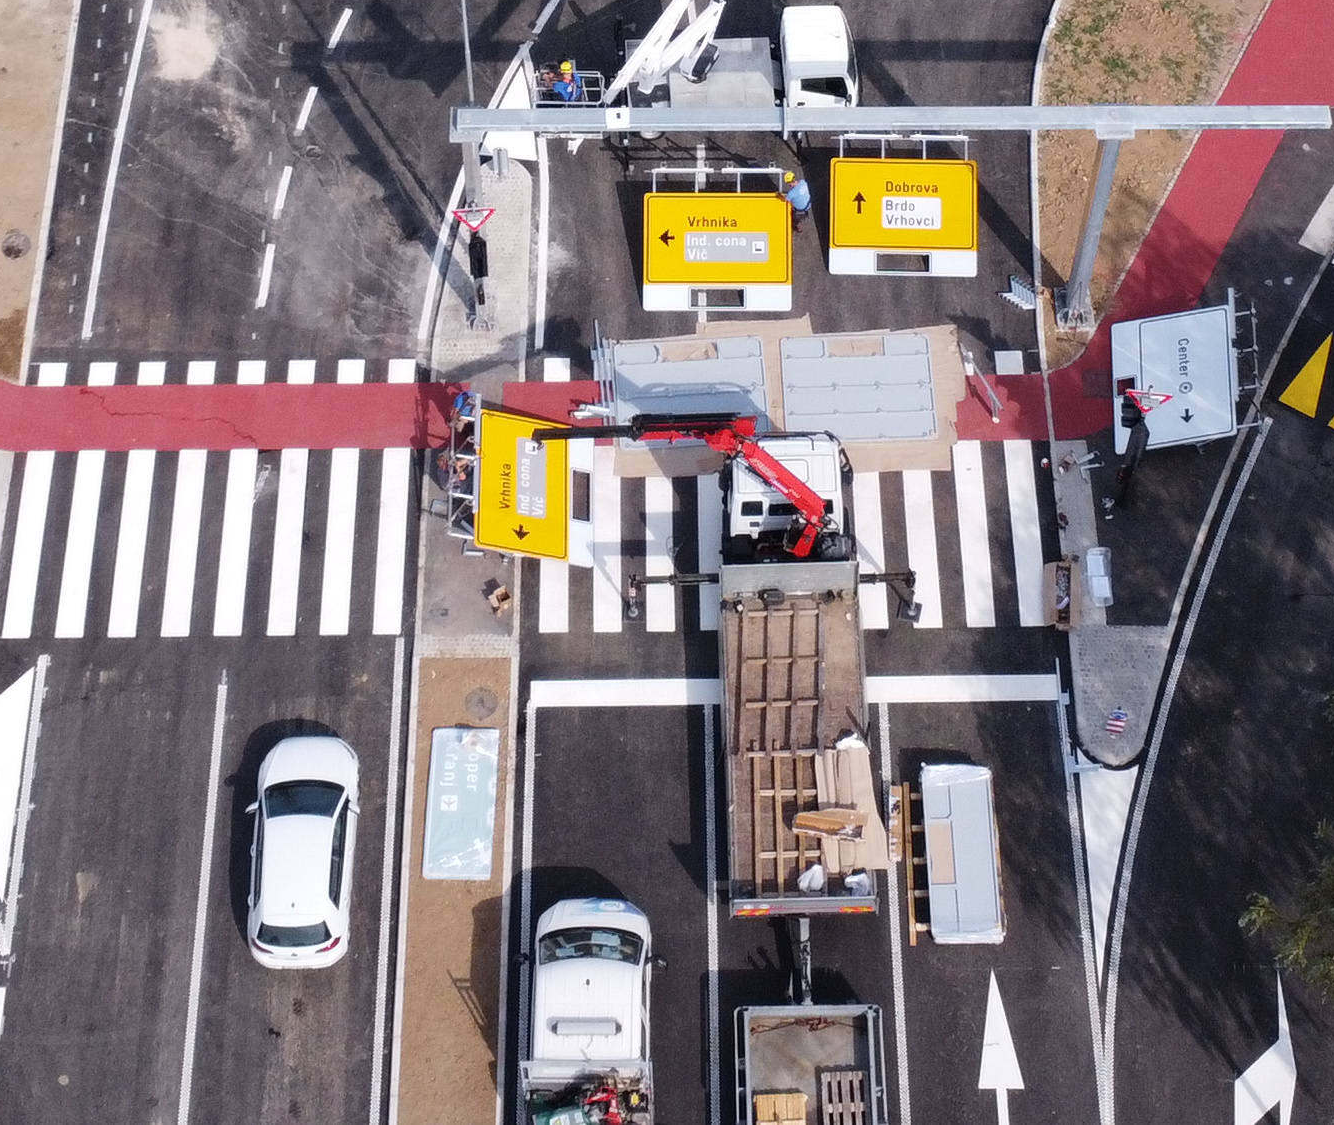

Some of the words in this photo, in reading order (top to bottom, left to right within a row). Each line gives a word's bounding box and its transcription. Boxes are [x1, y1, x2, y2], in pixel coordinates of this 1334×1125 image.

[885, 181, 939, 193] Dobrova
[885, 200, 916, 211] Brdo
[687, 216, 738, 228] Vrhnika
[885, 214, 935, 226] Vrhovci
[686, 234, 711, 247] Ind.
[715, 237, 747, 247] cona
[687, 248, 708, 260] Vič
[1177, 337, 1190, 378] Center
[520, 458, 530, 487] cona
[499, 463, 512, 509] Vrhnika
[464, 752, 480, 792] oper
